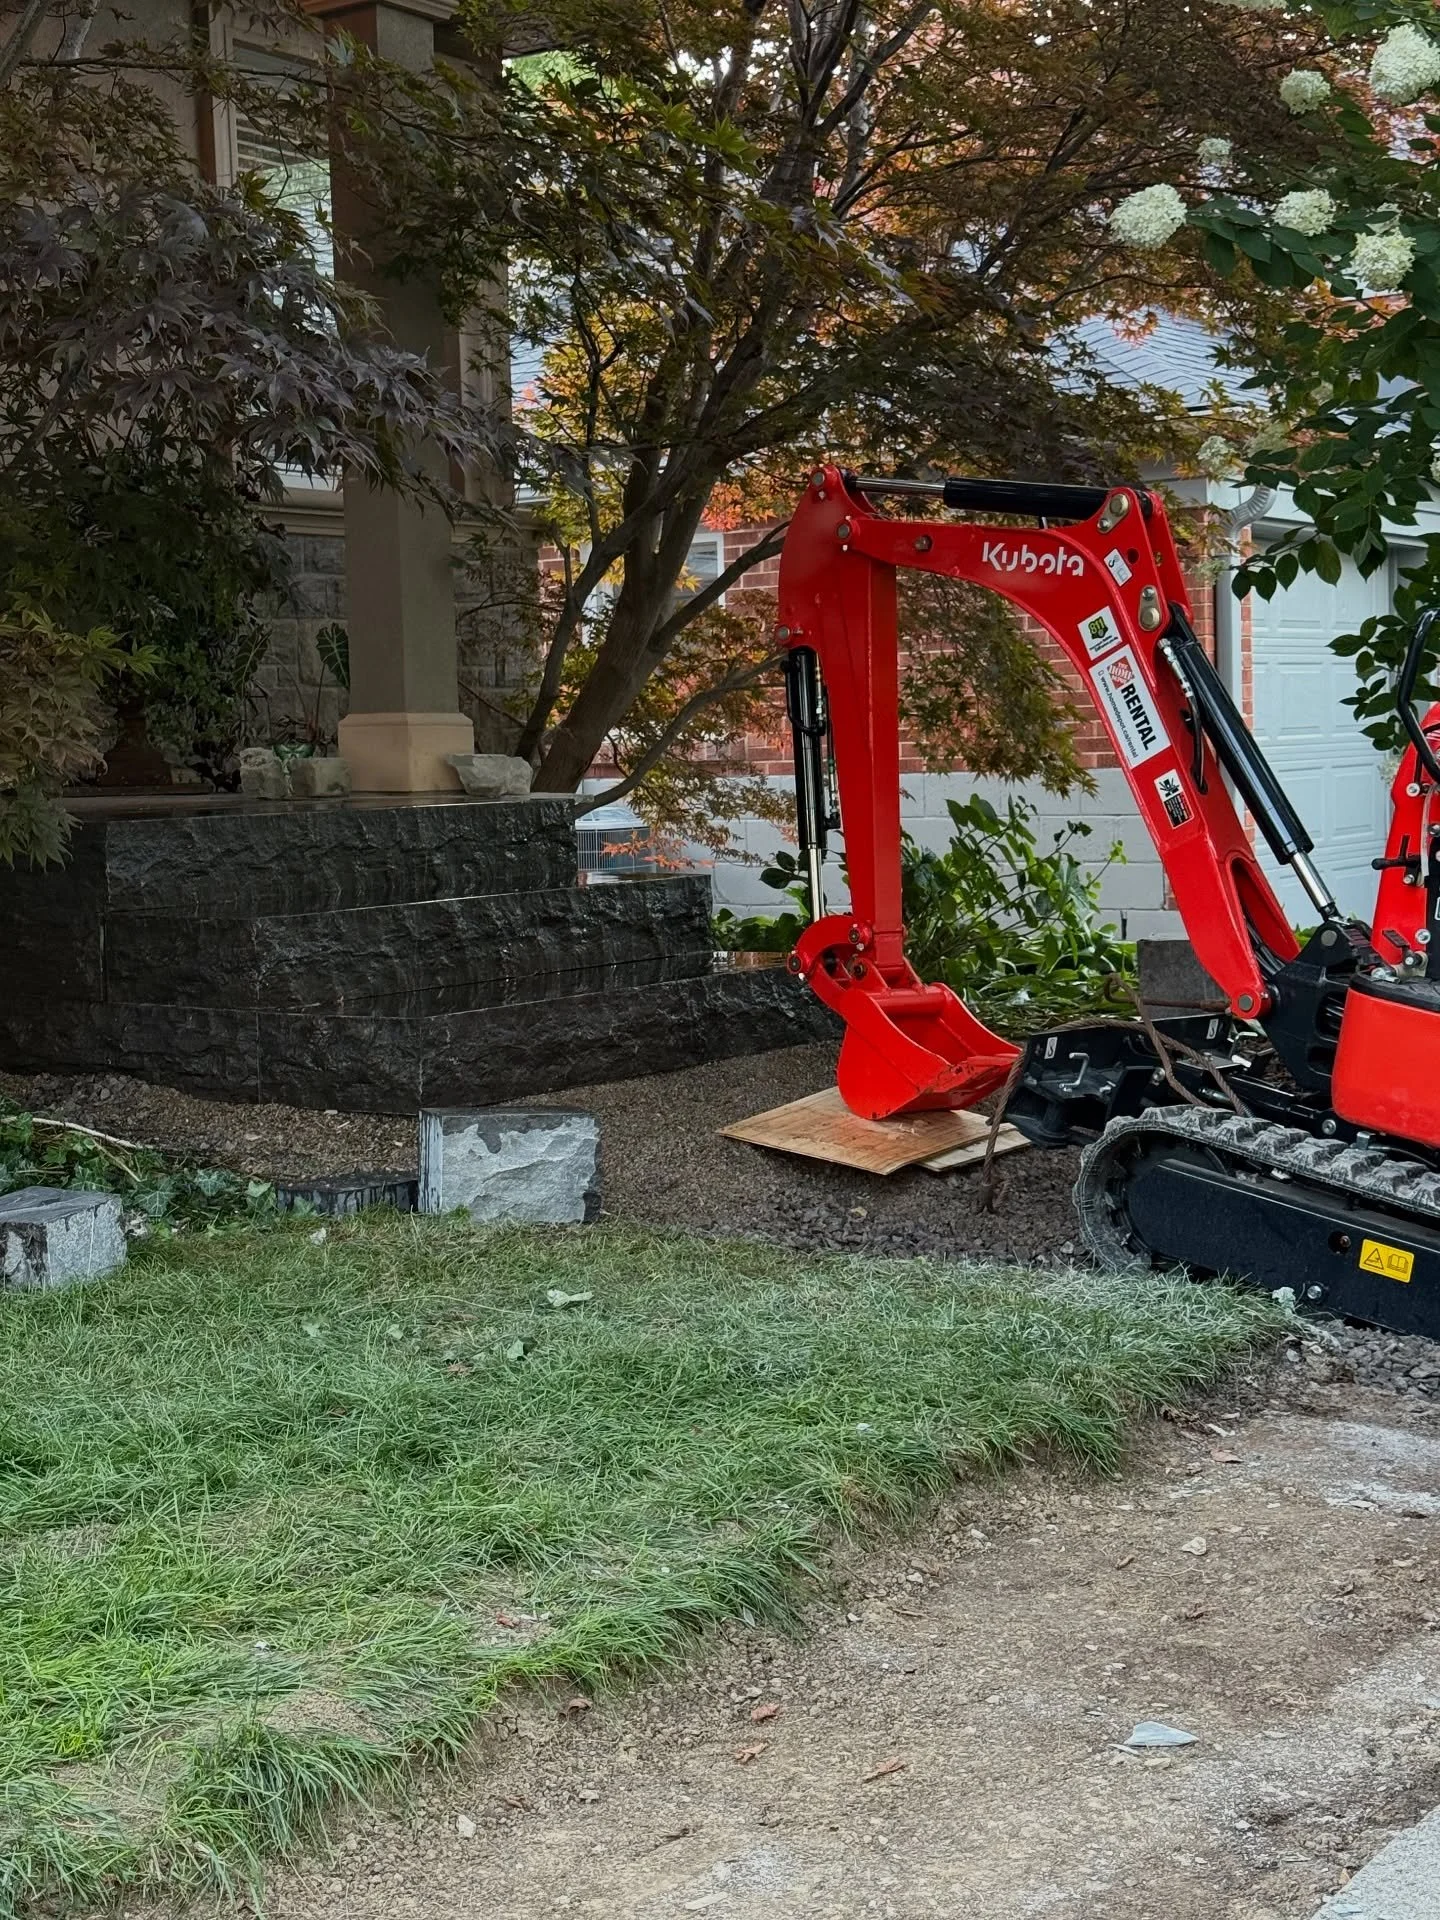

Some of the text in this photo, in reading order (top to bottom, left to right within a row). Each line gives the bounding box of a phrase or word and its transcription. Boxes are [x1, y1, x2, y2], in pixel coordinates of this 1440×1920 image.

[982, 542, 1084, 577] Kubota
[1089, 618, 1105, 634] 811
[1100, 676, 1139, 758] www.homedepot.ca/rental
[1121, 683, 1157, 751] RENTAL
